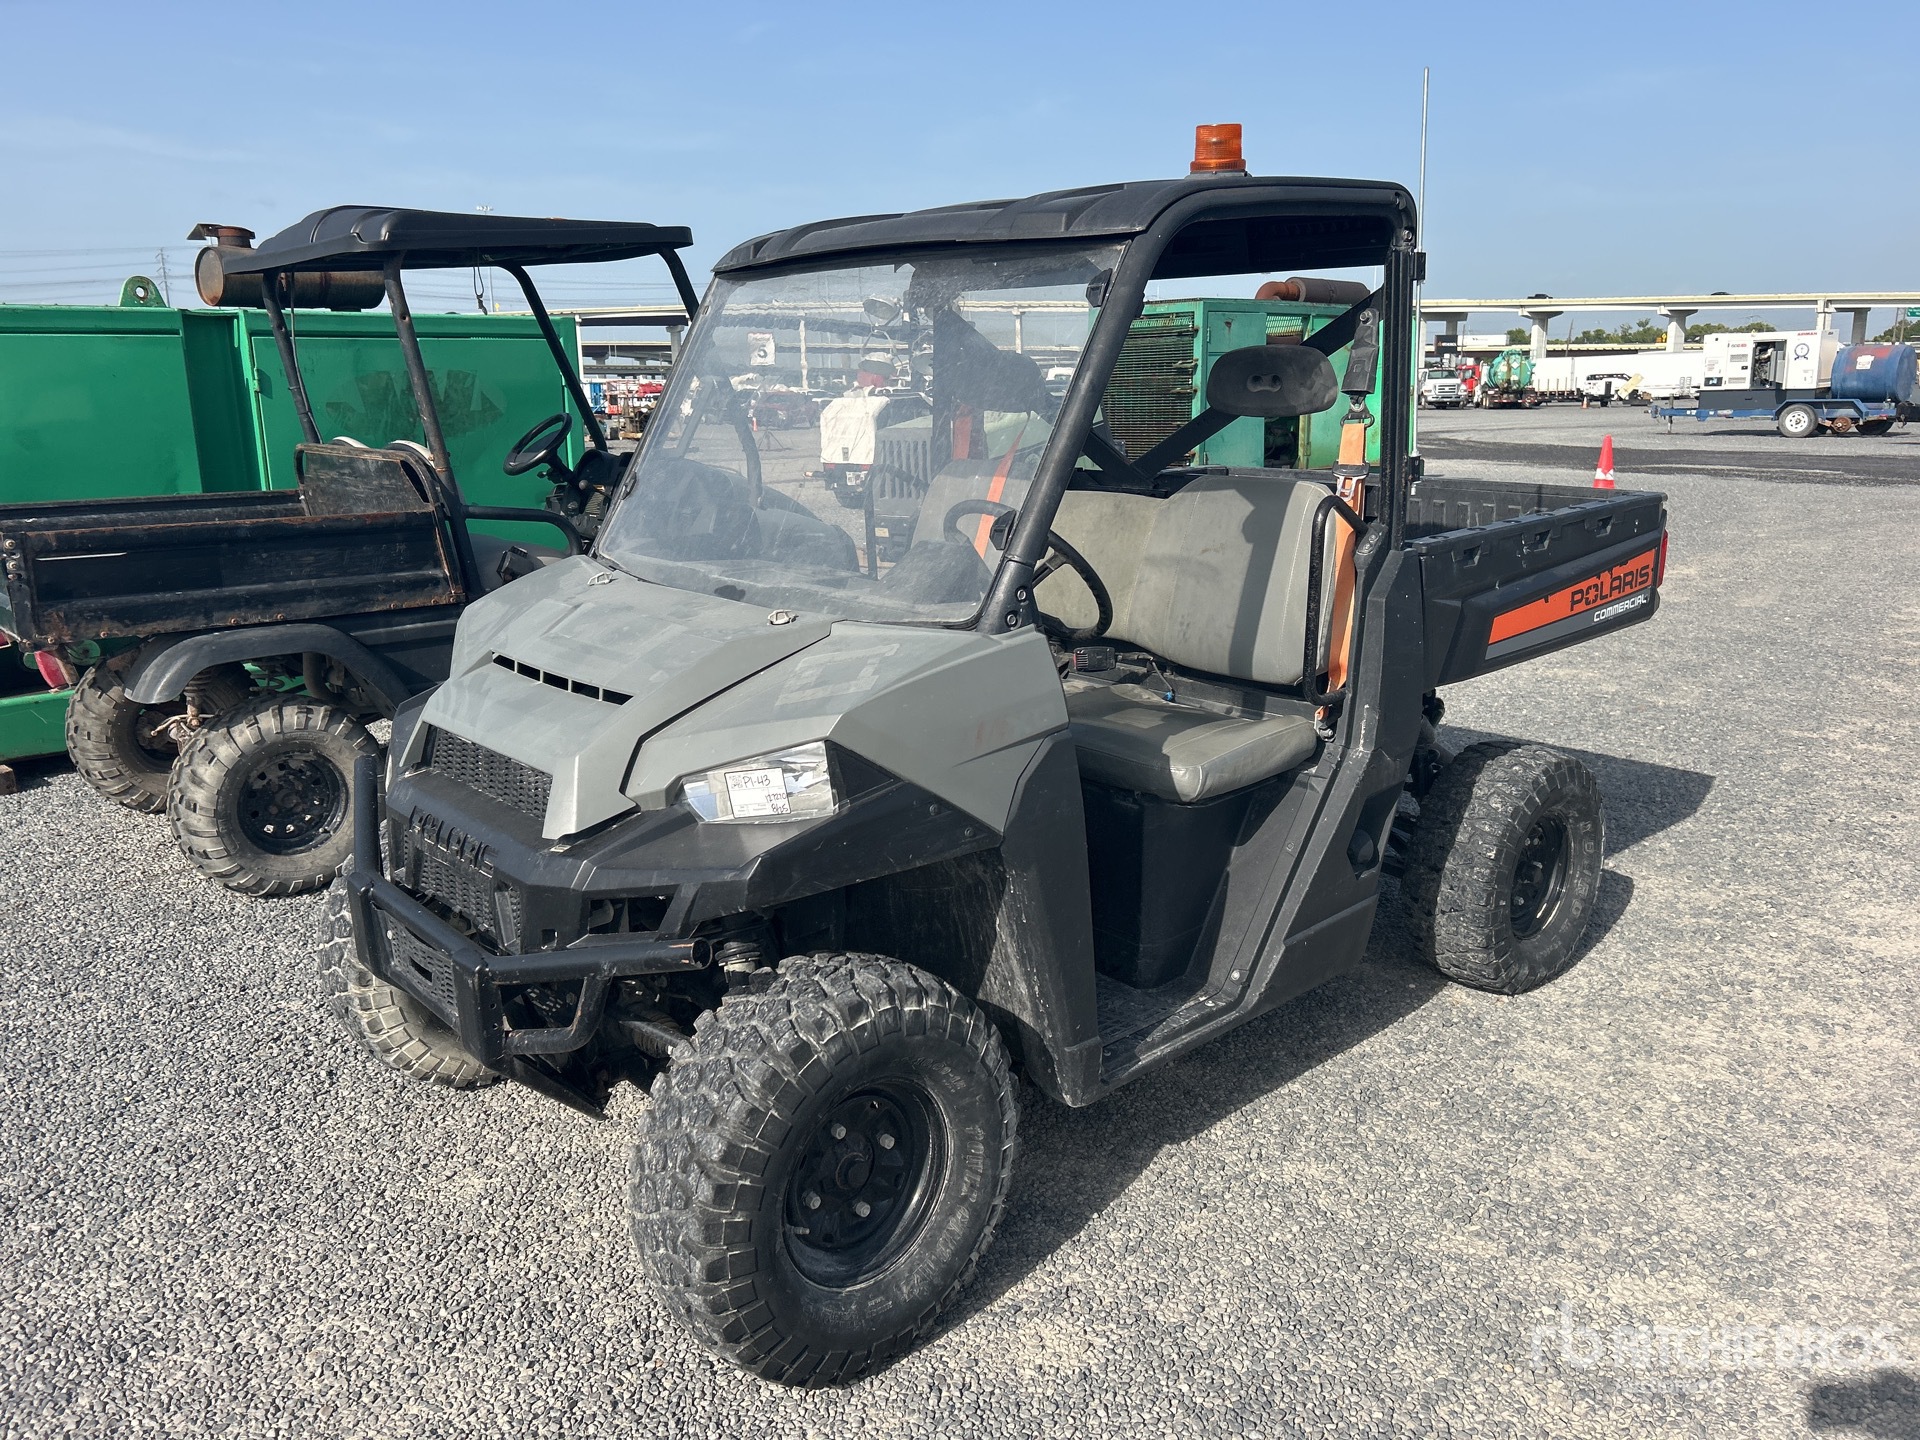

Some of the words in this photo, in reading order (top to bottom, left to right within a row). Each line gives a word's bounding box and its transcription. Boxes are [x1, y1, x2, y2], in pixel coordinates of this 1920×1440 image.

[757, 344, 768, 358] 5
[1570, 564, 1650, 612] POLARIS
[1593, 594, 1647, 622] COMMERCIAL
[408, 805, 498, 878] POLARIS
